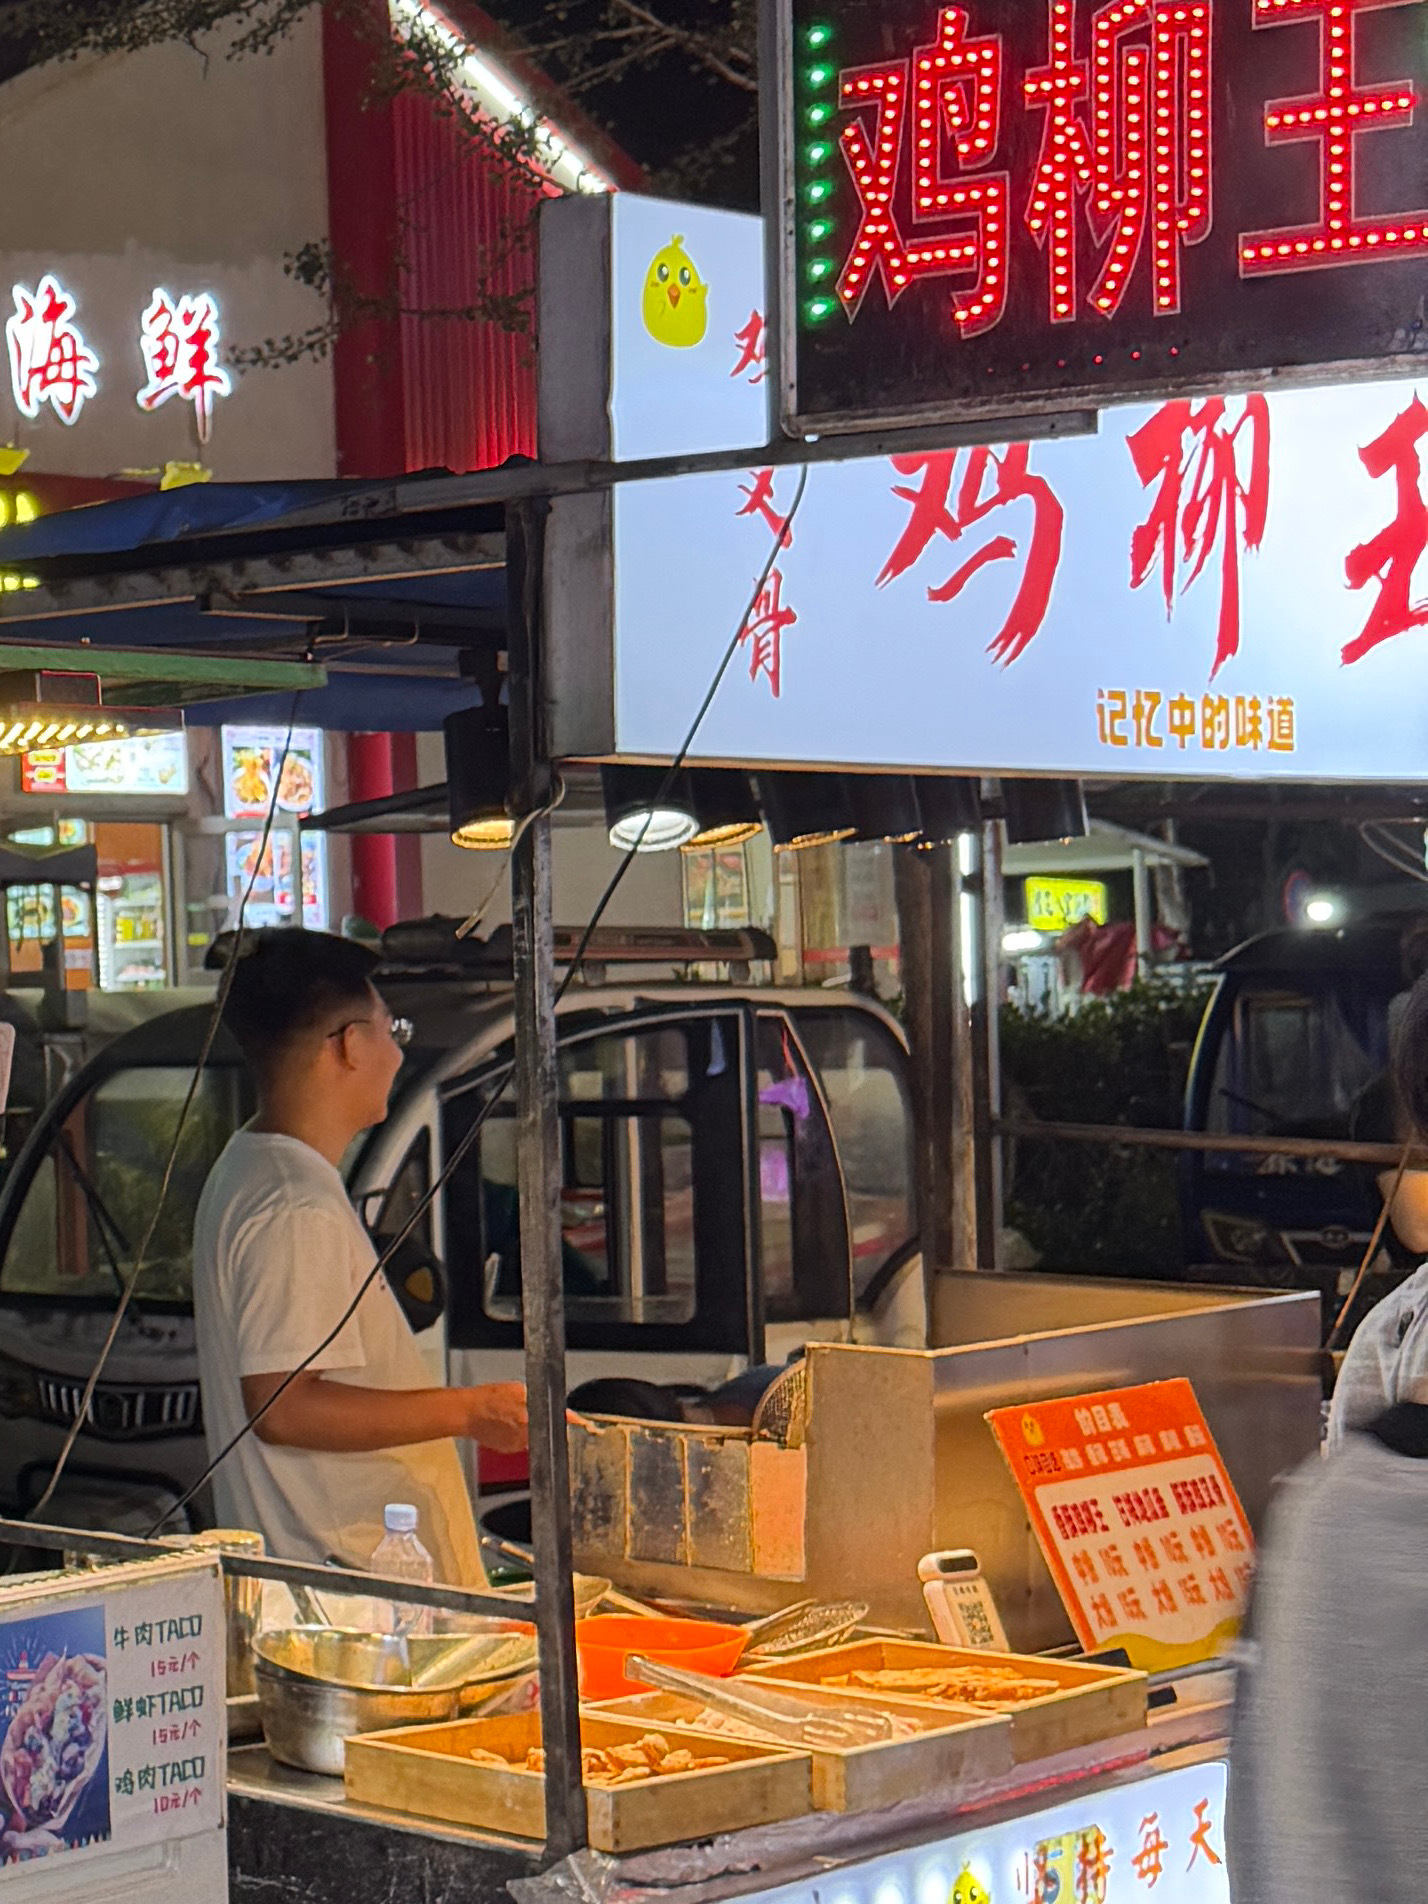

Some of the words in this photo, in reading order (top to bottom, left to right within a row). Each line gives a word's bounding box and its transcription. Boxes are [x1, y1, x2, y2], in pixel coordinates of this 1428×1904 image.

[6, 275, 232, 446] 海鲜
[1095, 688, 1296, 753] 记忆中的味道
[113, 1614, 203, 1650] 牛肉TACO
[113, 1685, 204, 1724] 鲜虾TACO
[115, 1756, 205, 1795] 鸡肉TACO
